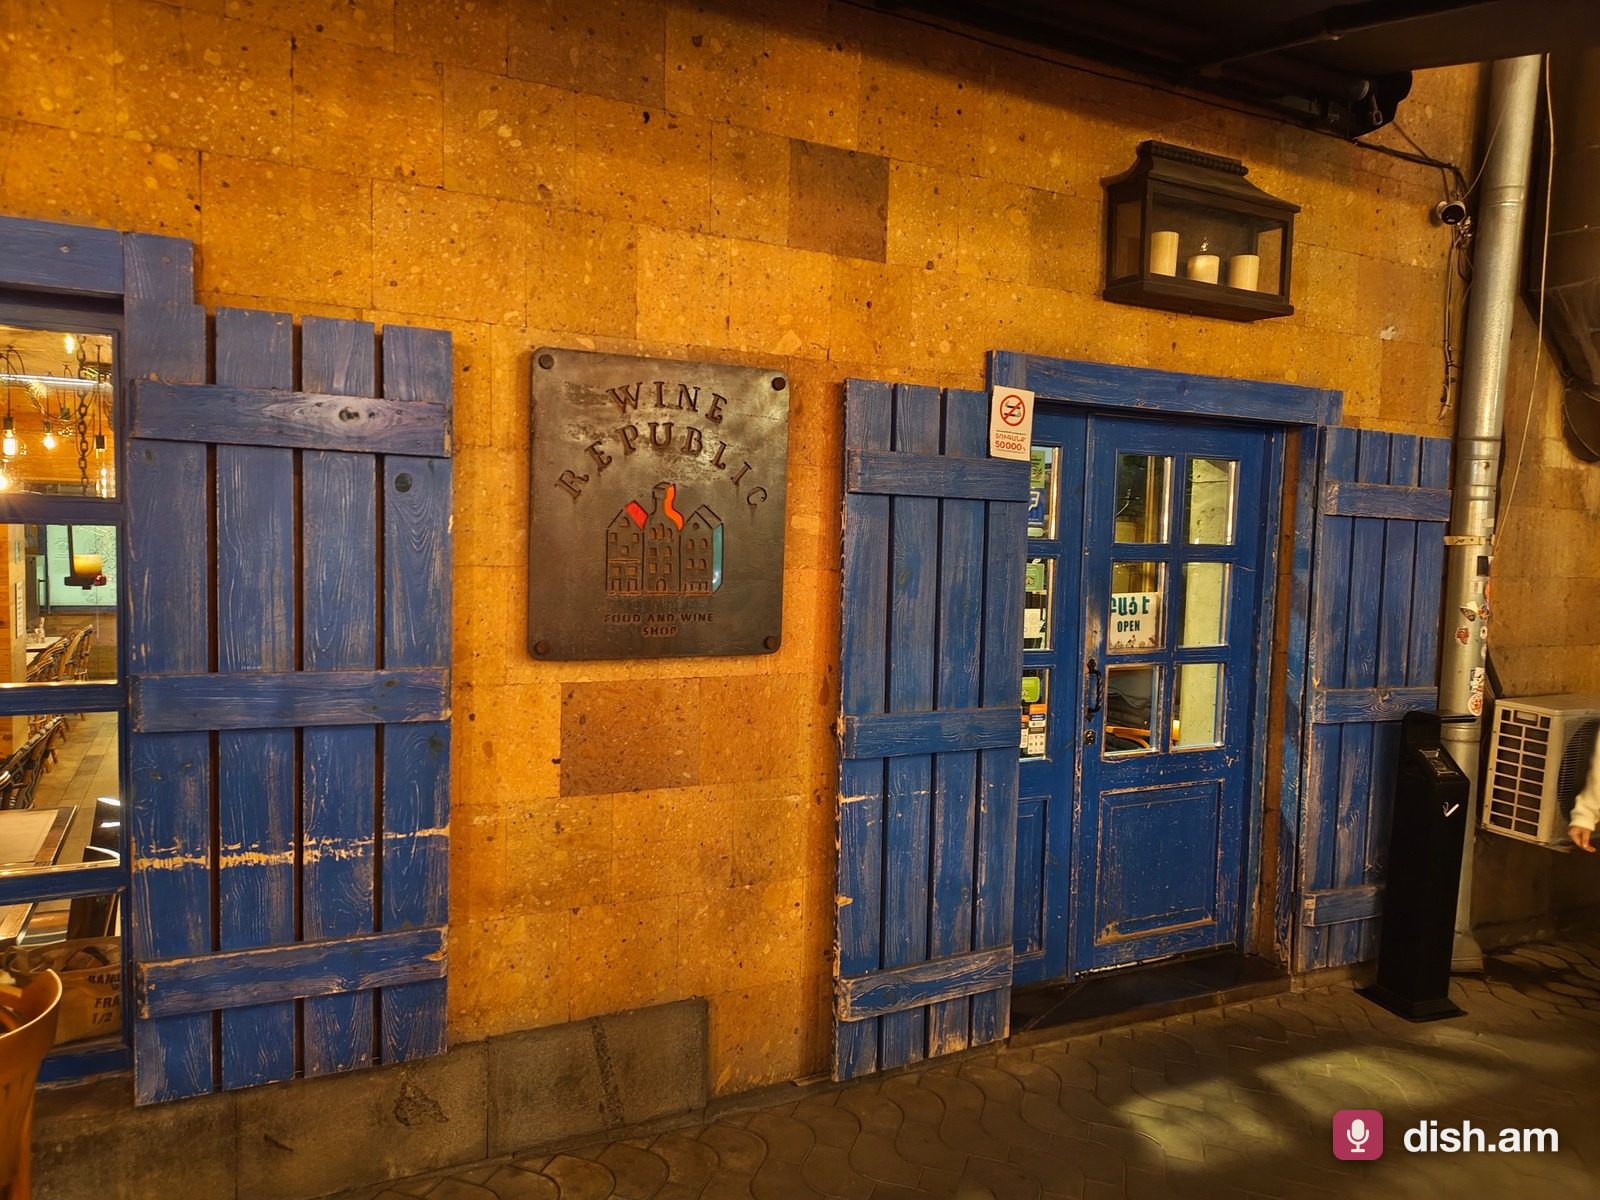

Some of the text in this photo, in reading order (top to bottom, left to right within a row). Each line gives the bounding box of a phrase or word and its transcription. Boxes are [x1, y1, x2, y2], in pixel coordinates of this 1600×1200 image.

[606, 381, 728, 424] WINE
[554, 422, 768, 507] REPUBLIC
[604, 613, 713, 623] FOOD AND WINE
[643, 626, 677, 636] SHOP
[1117, 620, 1140, 632] OPEN
